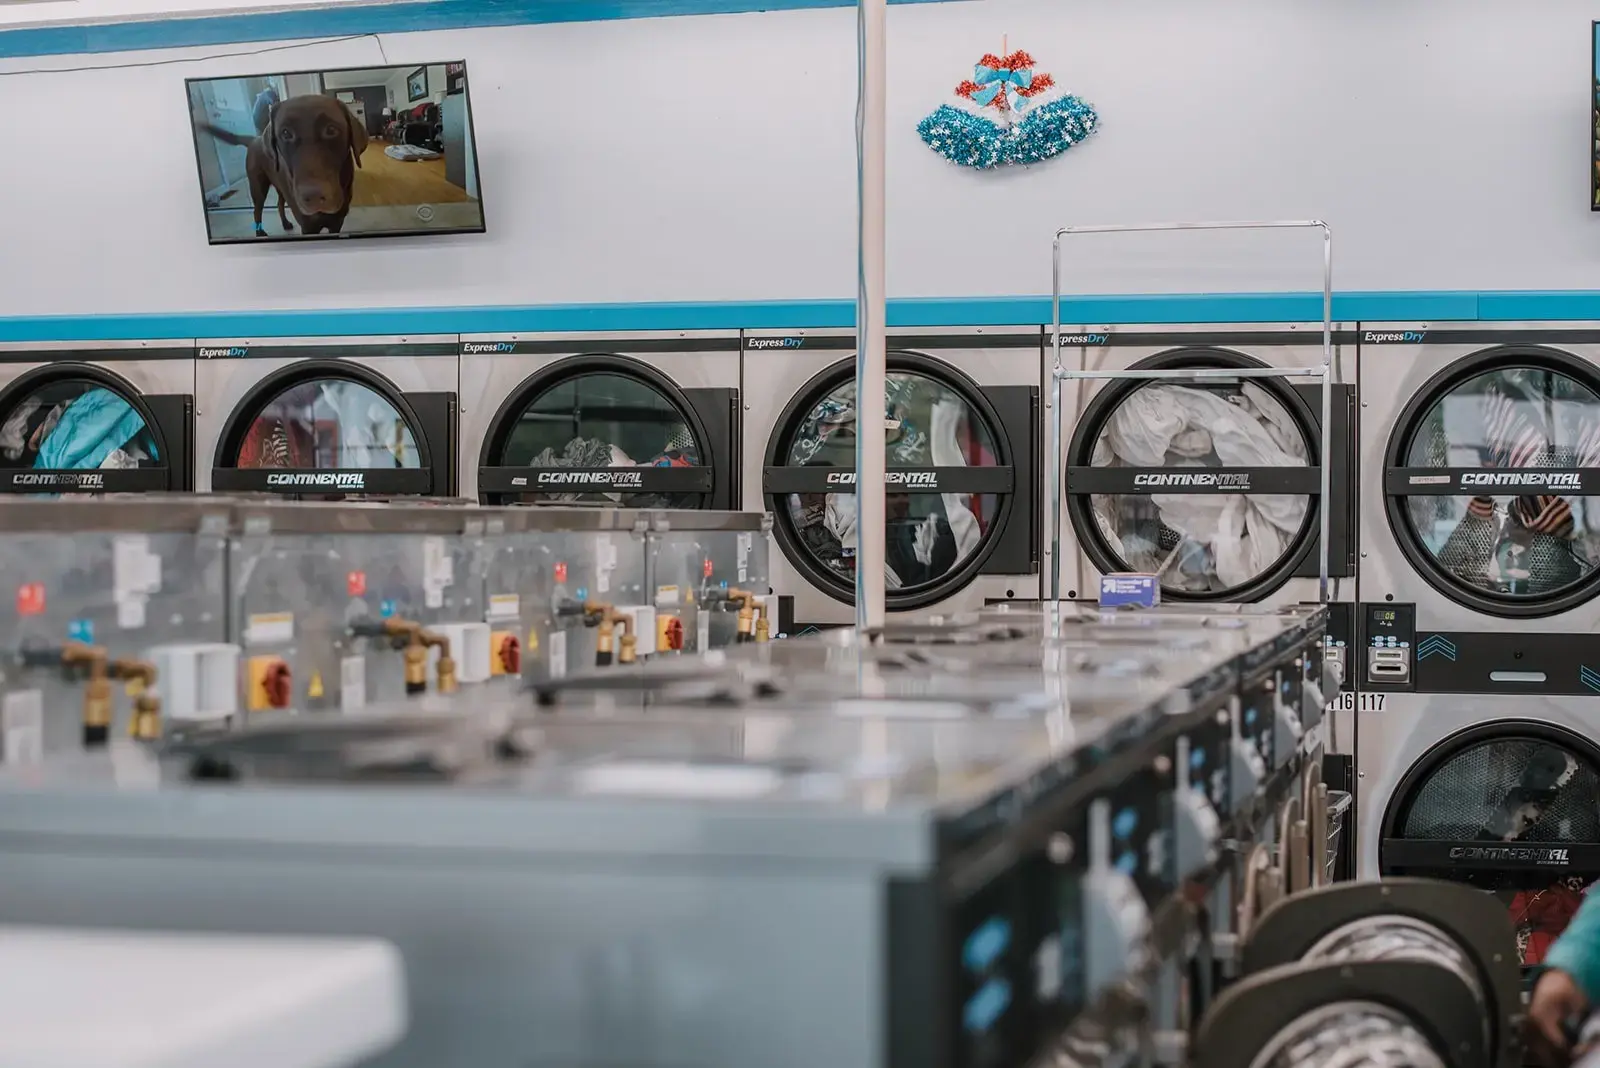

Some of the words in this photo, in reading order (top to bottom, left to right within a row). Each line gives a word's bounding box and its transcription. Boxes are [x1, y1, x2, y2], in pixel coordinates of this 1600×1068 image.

[748, 337, 805, 349] ExpressDry
[1364, 331, 1427, 344] ExpressDry
[199, 347, 249, 359] ExpressDry
[463, 342, 518, 354] ExpressDry
[13, 473, 104, 485] CONTINENTAL
[266, 473, 365, 485] CONTINENTAL
[537, 472, 643, 484] CONTINENTAL
[826, 472, 938, 484] COENTAL
[1134, 473, 1251, 485] CONTINENTAL
[1460, 473, 1582, 485] CONTINENTAL
[1360, 693, 1385, 711] 117
[1449, 847, 1570, 861] CONTINENTAL
